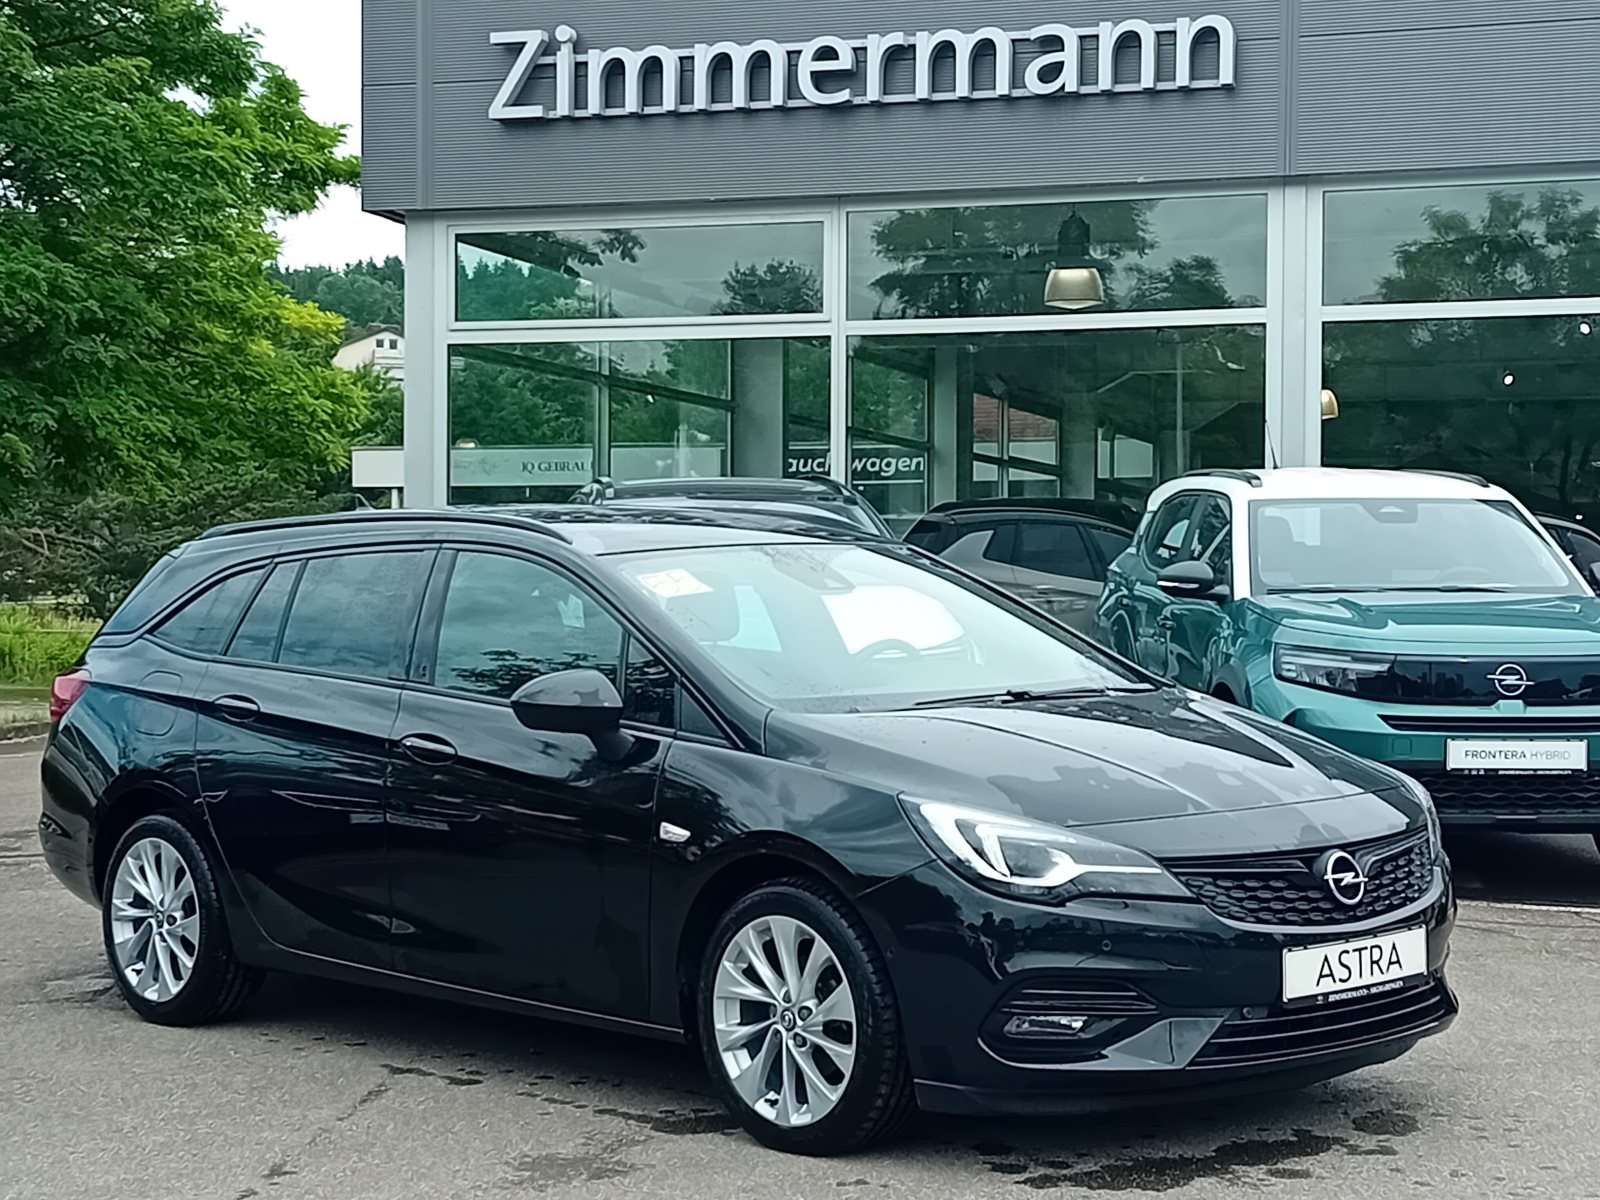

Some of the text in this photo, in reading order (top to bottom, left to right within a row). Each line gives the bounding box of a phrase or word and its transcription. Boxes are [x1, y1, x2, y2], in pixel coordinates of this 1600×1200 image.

[488, 14, 1237, 120] Zimmermann
[1464, 749, 1571, 760] FRONTERA HYBRID
[1315, 941, 1403, 987] ASTRA
